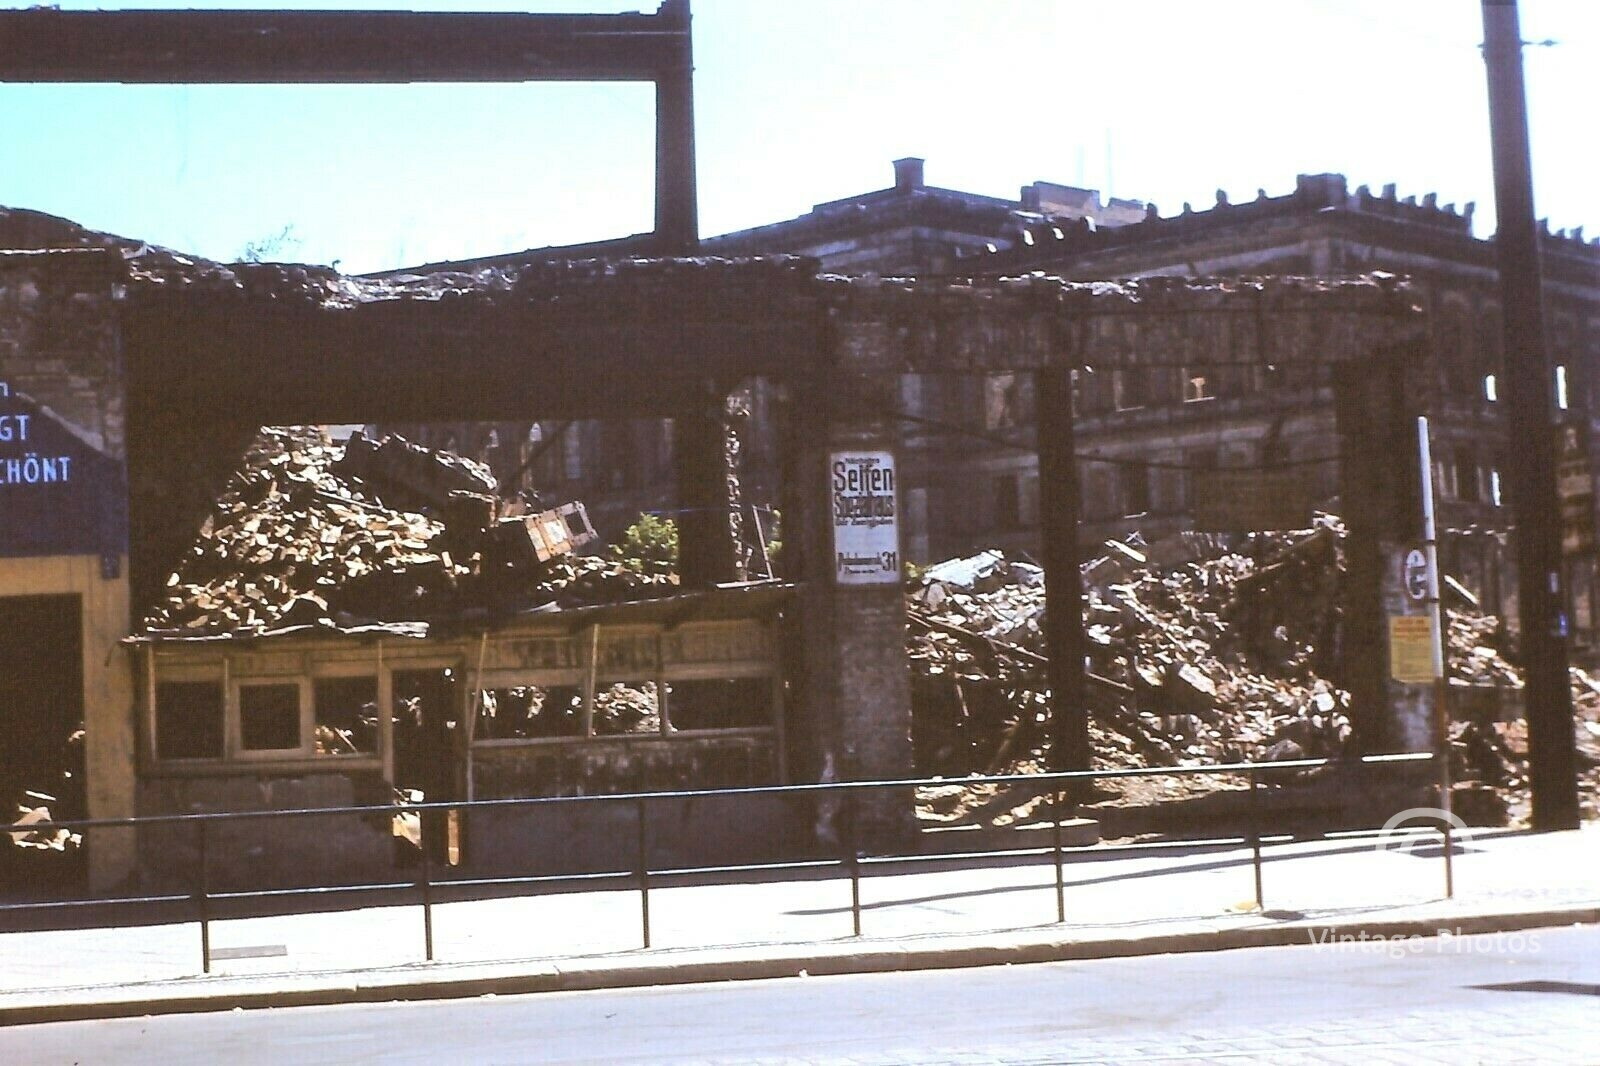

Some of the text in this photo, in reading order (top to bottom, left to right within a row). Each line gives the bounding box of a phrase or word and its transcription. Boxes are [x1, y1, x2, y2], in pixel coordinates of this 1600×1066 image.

[0, 452, 70, 484] HÖNT
[834, 461, 893, 492] Seifen
[882, 551, 897, 572] 31
